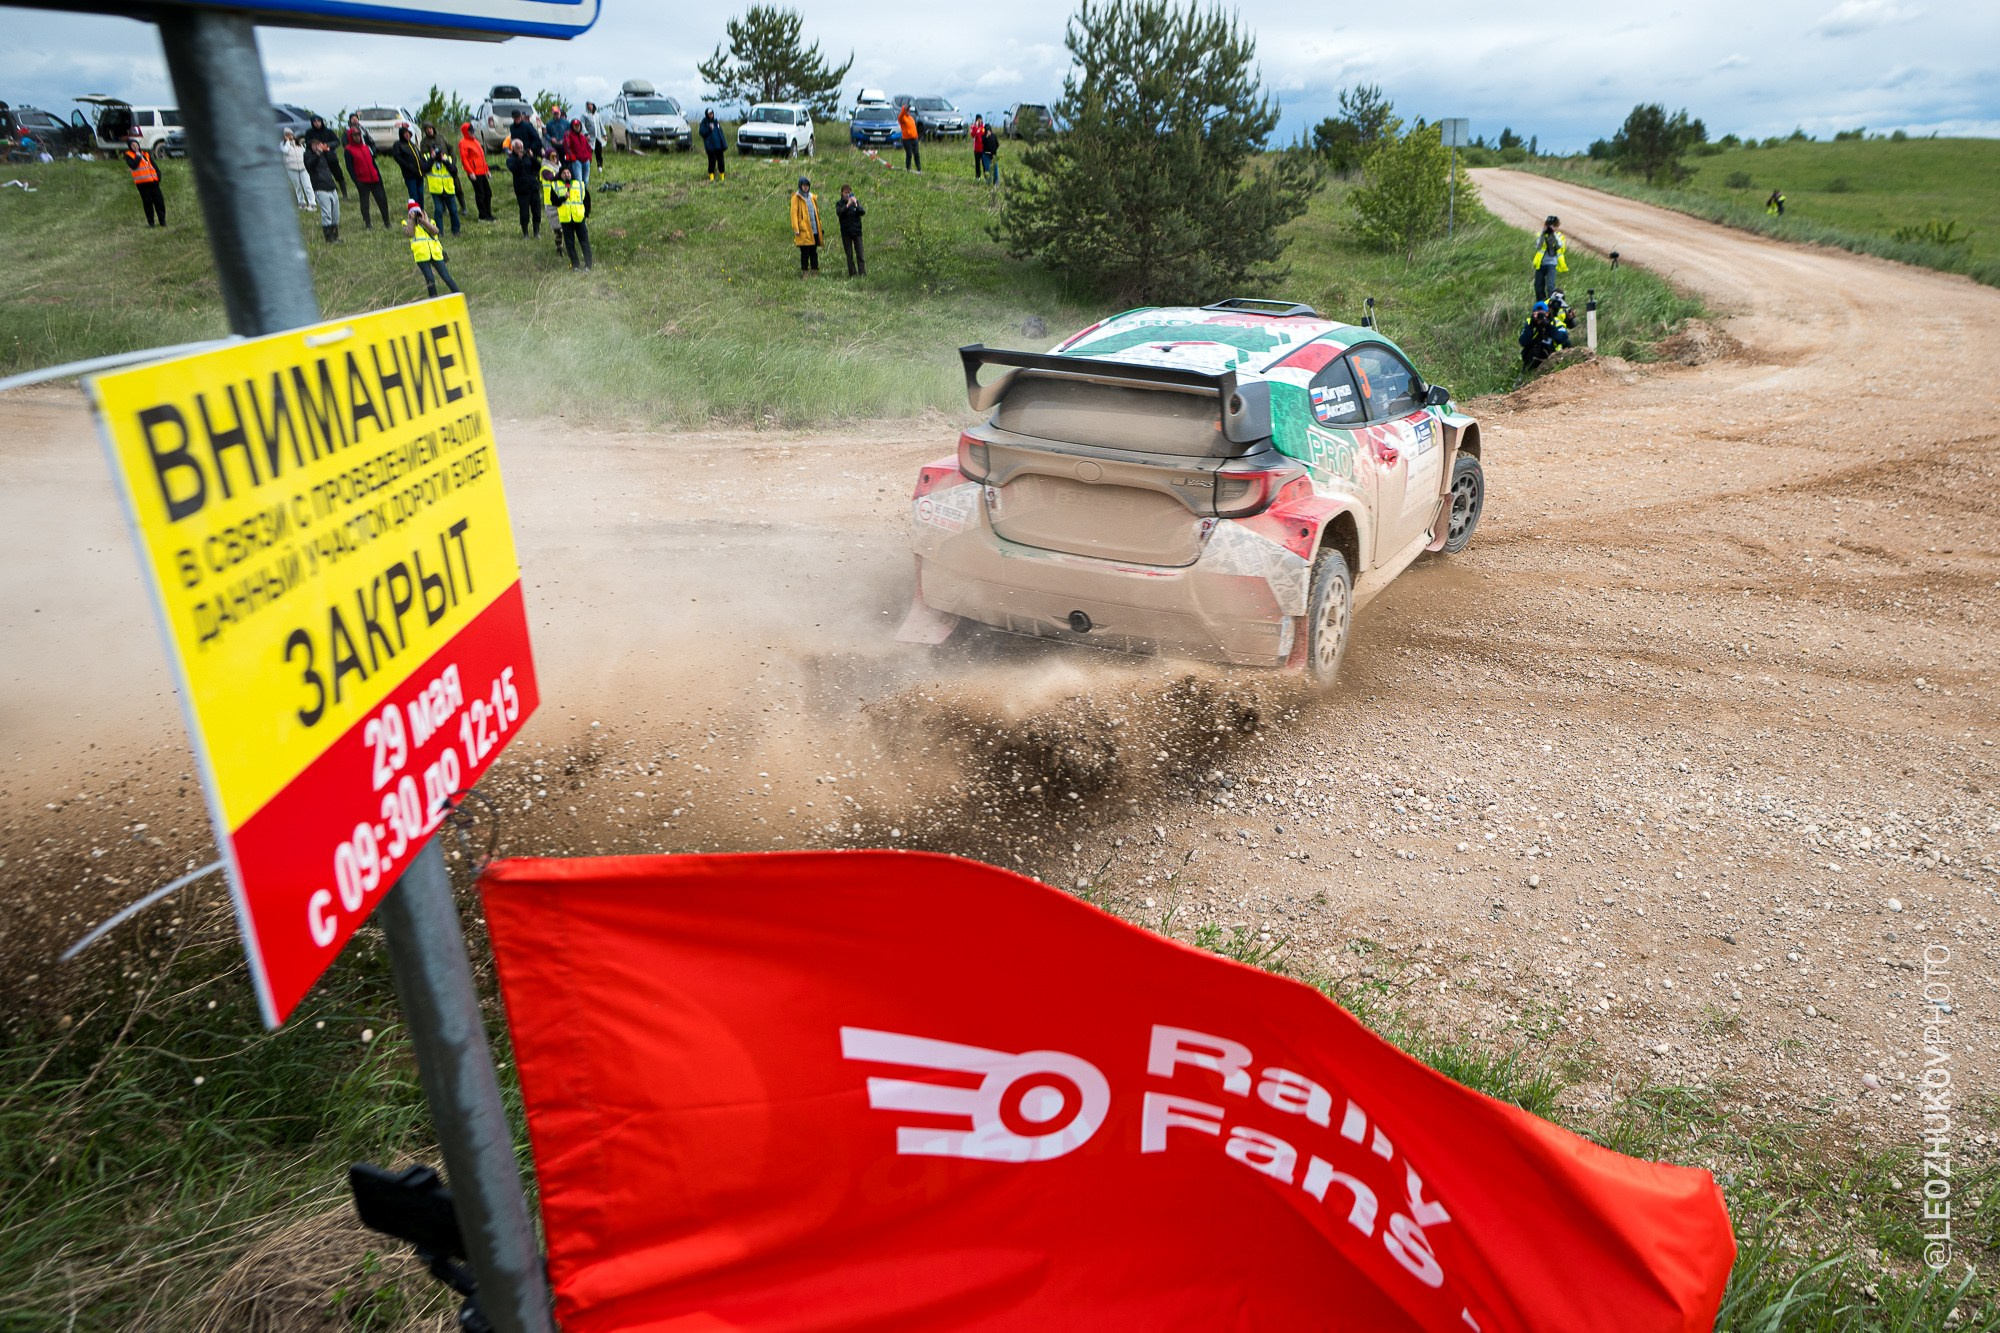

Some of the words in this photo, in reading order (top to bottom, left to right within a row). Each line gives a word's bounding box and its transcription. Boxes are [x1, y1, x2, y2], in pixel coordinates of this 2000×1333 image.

[138, 321, 474, 524] ВНИМАНИЕ!
[1352, 355, 1372, 399] 5
[175, 548, 201, 590] В
[204, 501, 293, 574] СВЯЗИ
[291, 494, 314, 530] С
[311, 434, 439, 519] ПРОВЕДЕНИЕМ
[439, 411, 485, 447] РАЛЛИ
[192, 544, 306, 648] ДАННЫЙ
[301, 500, 390, 578] УЧАСТОК
[389, 472, 451, 528] ДОРОГИ
[448, 446, 492, 491] БУДЕТ
[284, 516, 473, 728] ЗАКРЫТ
[334, 772, 422, 913] 09:30
[421, 747, 461, 836] до
[459, 665, 520, 769] 12:15
[364, 702, 409, 793] 29
[407, 662, 464, 749] мая
[1140, 1091, 1445, 1289] Fans
